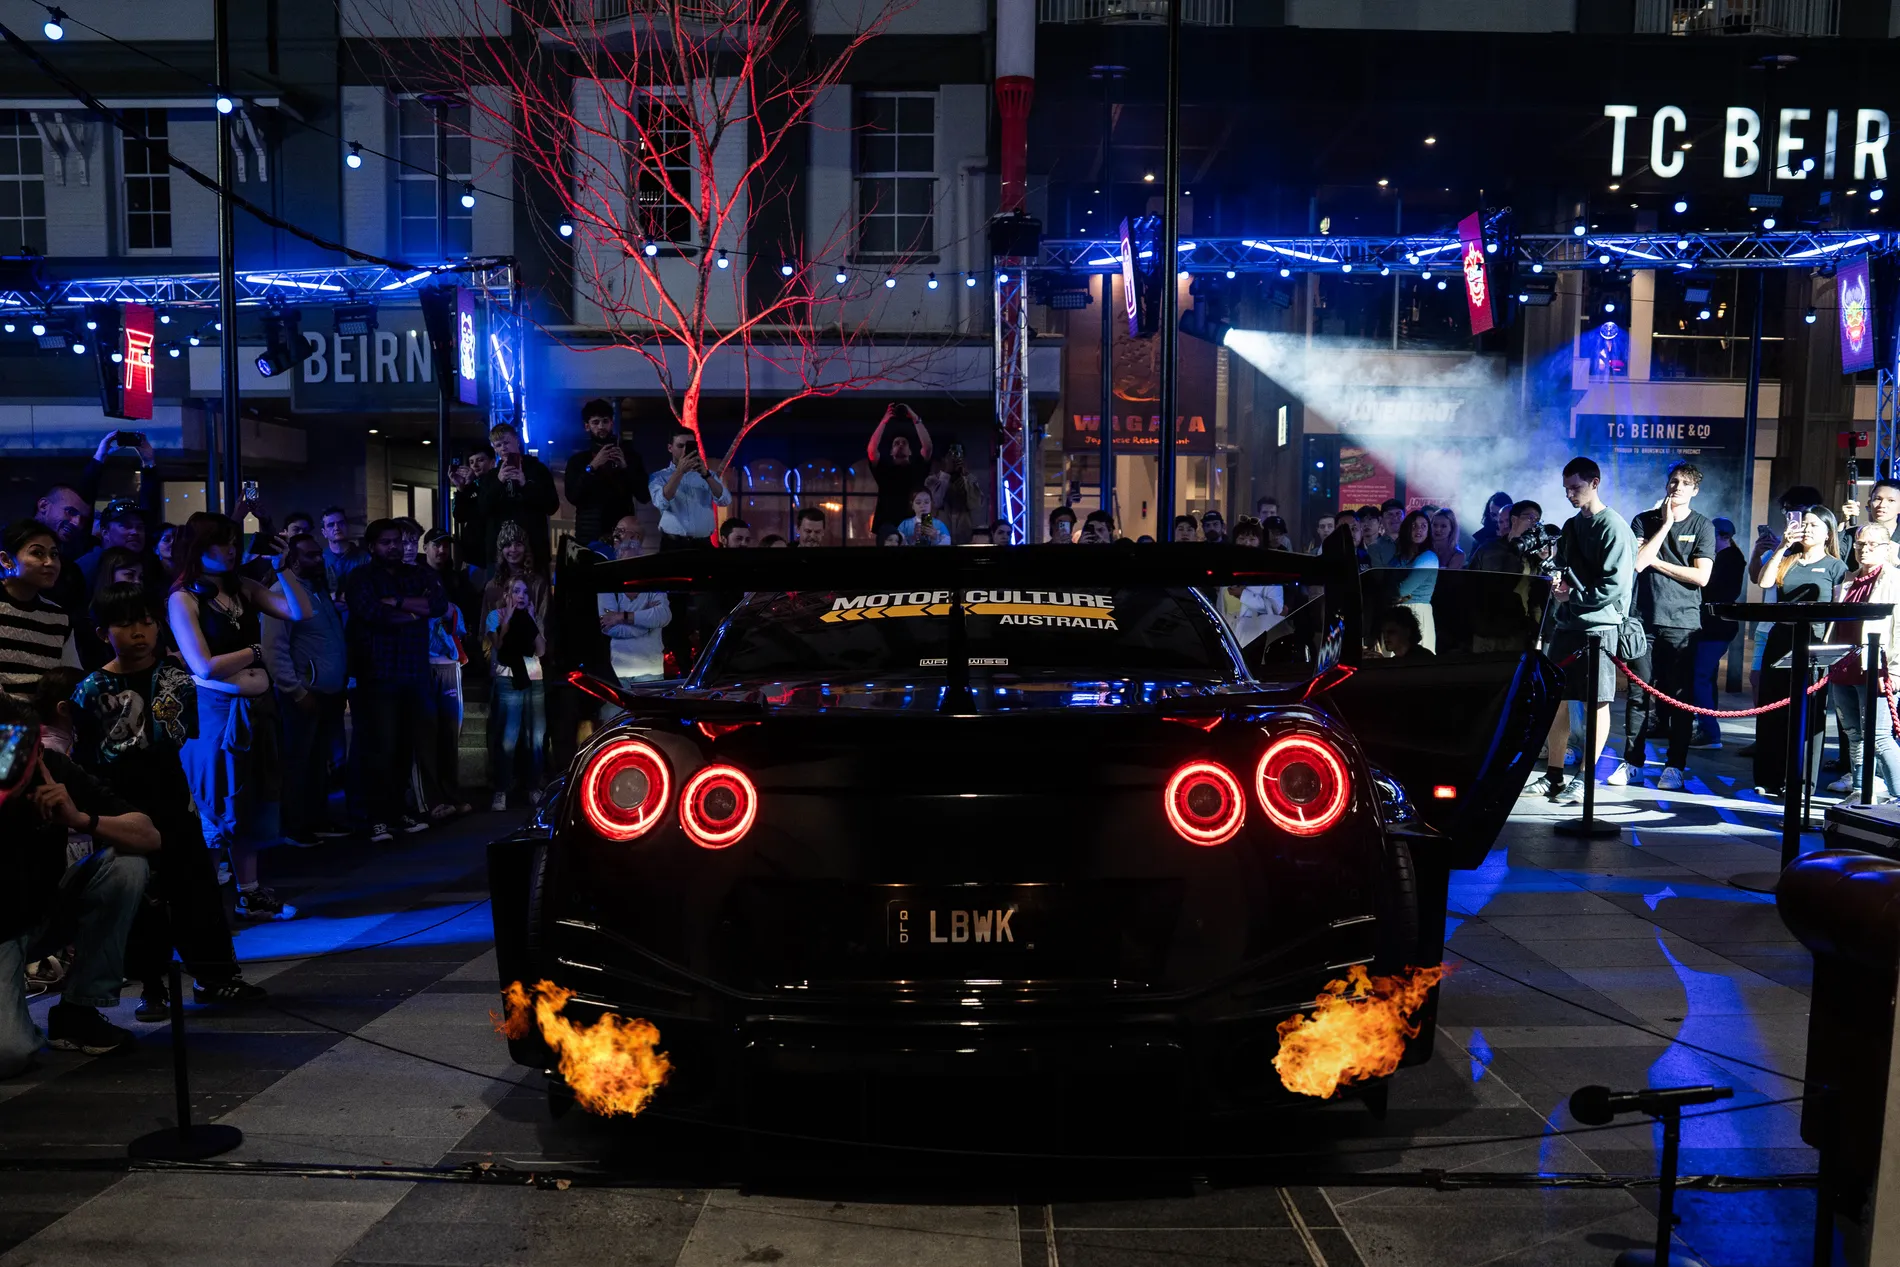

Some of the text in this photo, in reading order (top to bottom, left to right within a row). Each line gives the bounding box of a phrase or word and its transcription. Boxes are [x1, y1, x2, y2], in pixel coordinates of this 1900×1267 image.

[1604, 105, 1891, 181] TC BEIR
[302, 331, 432, 383] BEIRN
[1084, 435, 1191, 445] Japnese Restant
[1608, 423, 1625, 438] TC
[1631, 423, 1685, 439] BEIRNE
[831, 590, 1116, 611] MOTOR CULTURE
[999, 614, 1119, 631] AUSTRALIA
[899, 909, 1015, 944] QLD LBWK
